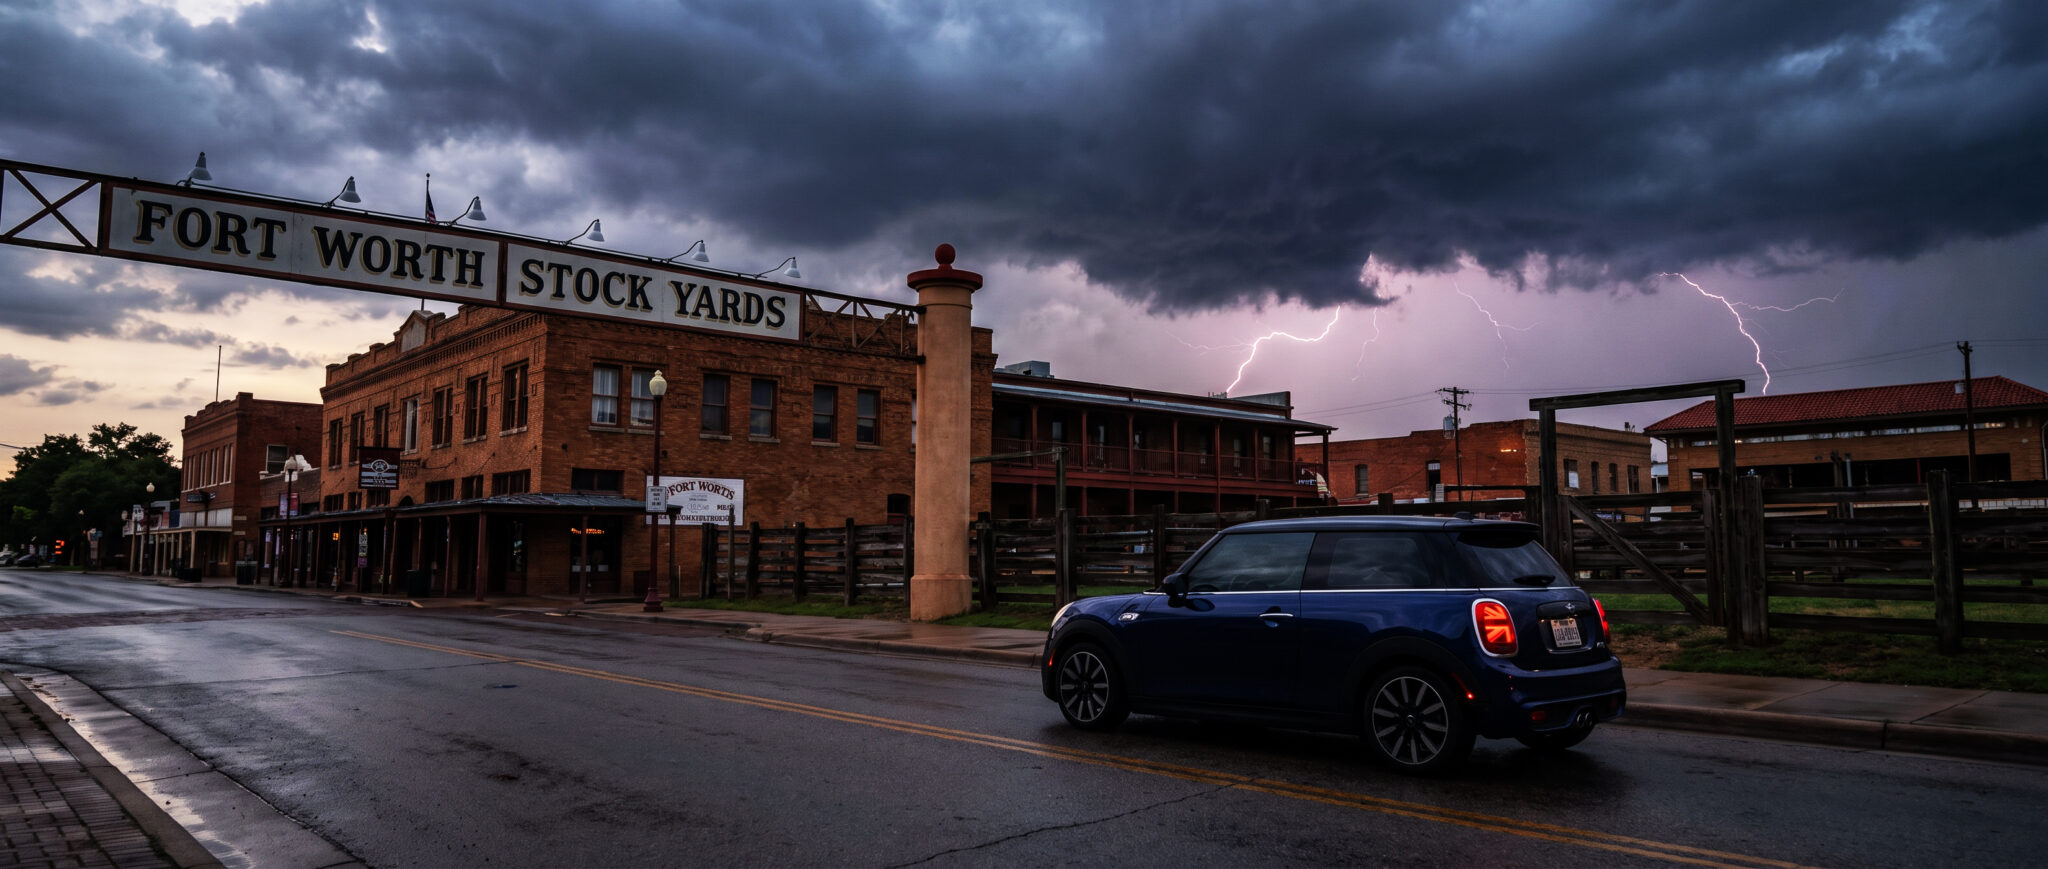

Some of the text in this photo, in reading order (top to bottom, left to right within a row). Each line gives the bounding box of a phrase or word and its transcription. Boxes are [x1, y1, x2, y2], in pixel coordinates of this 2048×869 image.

[134, 200, 485, 288] FORT WORTH
[520, 259, 786, 328] STOCK YARDS
[669, 482, 695, 496] FORT
